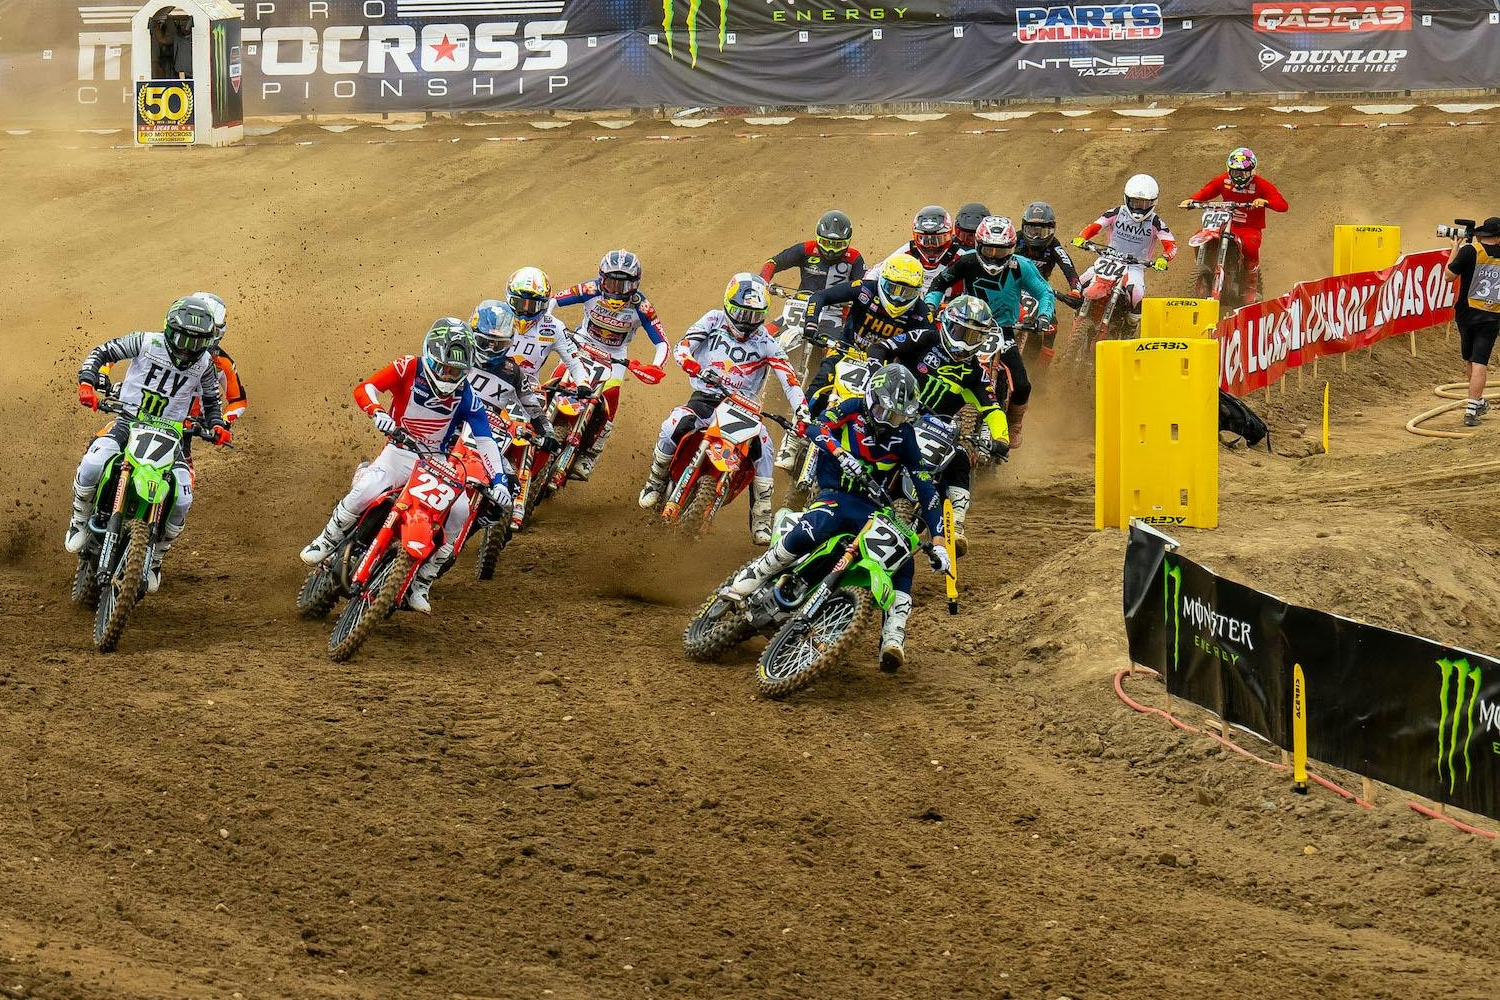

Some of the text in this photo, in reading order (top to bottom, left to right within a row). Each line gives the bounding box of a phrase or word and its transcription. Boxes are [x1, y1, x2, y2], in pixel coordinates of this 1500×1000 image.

[256, 0, 386, 21] PRO
[773, 7, 908, 22] ENERGY
[1016, 3, 1162, 28] PARTS
[1257, 6, 1406, 28] GASGAS
[1018, 25, 1161, 43] UNLIMITED
[78, 19, 568, 81] MOCROSS
[1018, 55, 1165, 70] INTENSE
[1286, 50, 1408, 64] DUNLOP
[1282, 64, 1397, 73] MOTORCYCLE TIRES
[144, 86, 189, 121] 50
[1115, 220, 1152, 237] CANVAS
[1094, 259, 1126, 278] 204
[1374, 265, 1424, 327] LUCAS
[1426, 263, 1455, 311] OIL
[590, 310, 632, 328] GASGAS
[1136, 342, 1189, 352] ACERBIS
[1247, 309, 1290, 373] LUCAS
[144, 362, 188, 398] FLY
[471, 373, 509, 401] OX
[718, 408, 760, 435] 7
[134, 431, 176, 463] 17
[408, 473, 456, 512] 23
[1136, 516, 1187, 524] ACERB
[865, 525, 909, 570] 21
[1183, 595, 1254, 651] MONSTER
[1194, 635, 1240, 666] ENERGY
